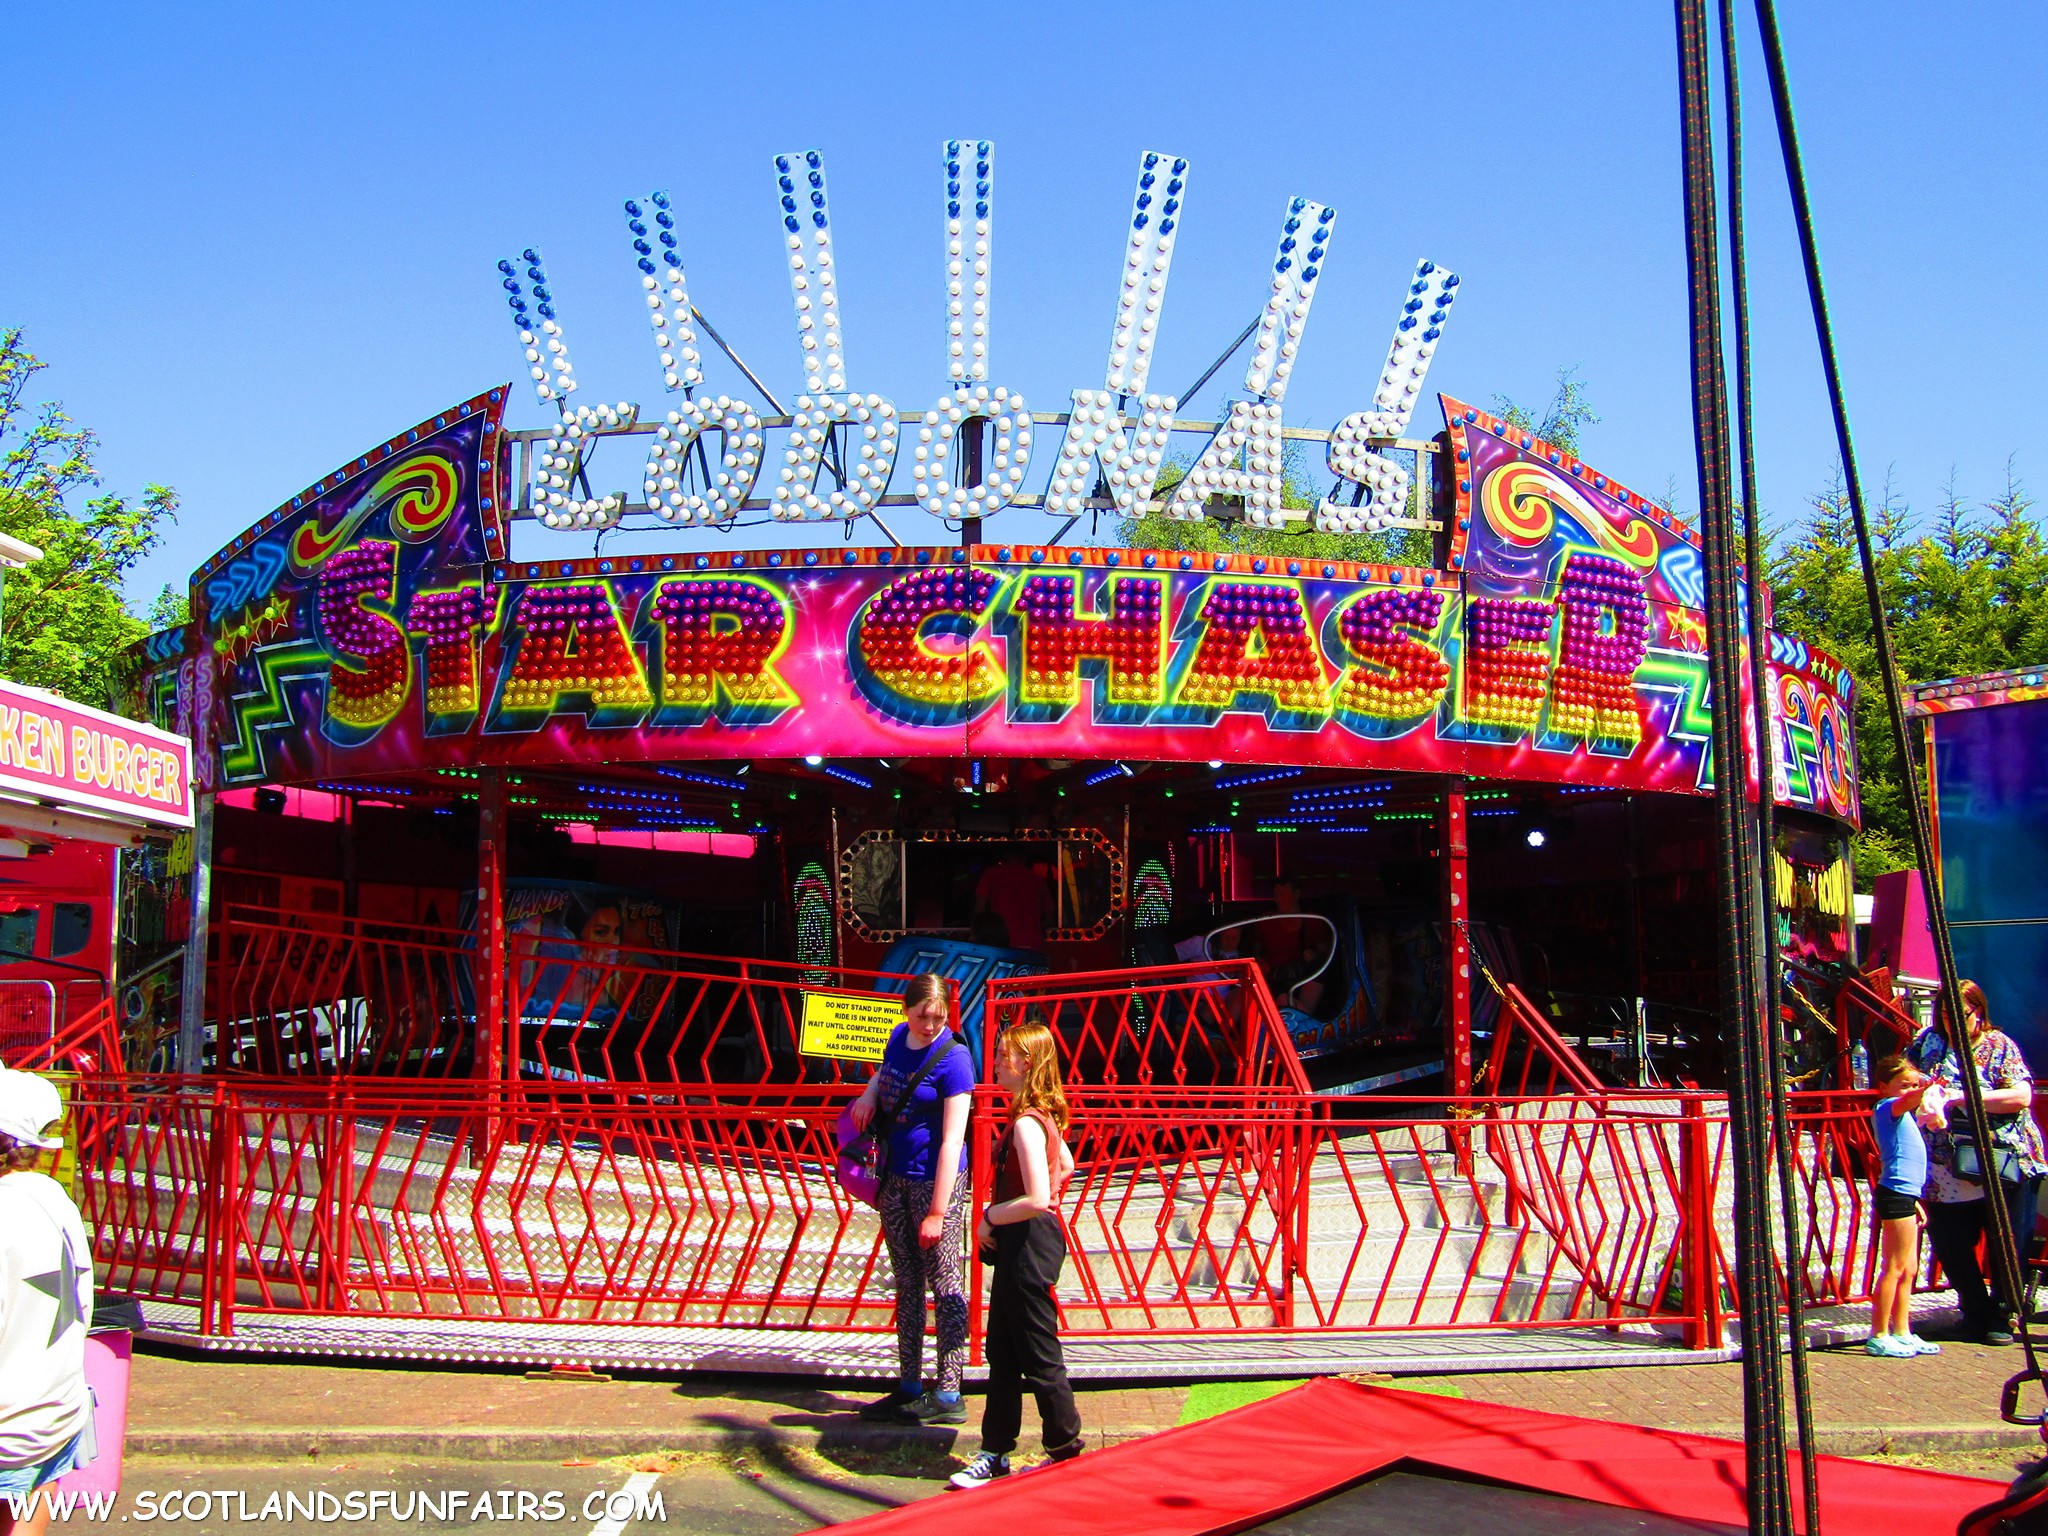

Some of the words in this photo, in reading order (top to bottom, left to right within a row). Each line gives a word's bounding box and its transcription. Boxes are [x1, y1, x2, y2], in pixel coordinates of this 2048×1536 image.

[530, 384, 1412, 534] CODONAS
[314, 538, 802, 748] STAR
[852, 545, 1650, 758] CHASER
[176, 658, 194, 738] CRA
[195, 655, 213, 788] SPIN
[1765, 667, 1790, 801] SPEED
[72, 725, 182, 806] BURGER
[808, 1020, 824, 1028] WAIT
[825, 1022, 845, 1030] UNTIL
[846, 1024, 888, 1034] COMPLETELY
[825, 1001, 835, 1009] DO
[836, 1002, 849, 1010] NOT
[851, 1004, 872, 1013] STAND
[884, 1007, 904, 1016] WHILE
[836, 1033, 850, 1041] AND
[851, 1034, 888, 1045] ATTENDANT
[868, 1016, 893, 1025] MOTION
[841, 1044, 867, 1053] OPENED
[869, 1046, 882, 1055] THE
